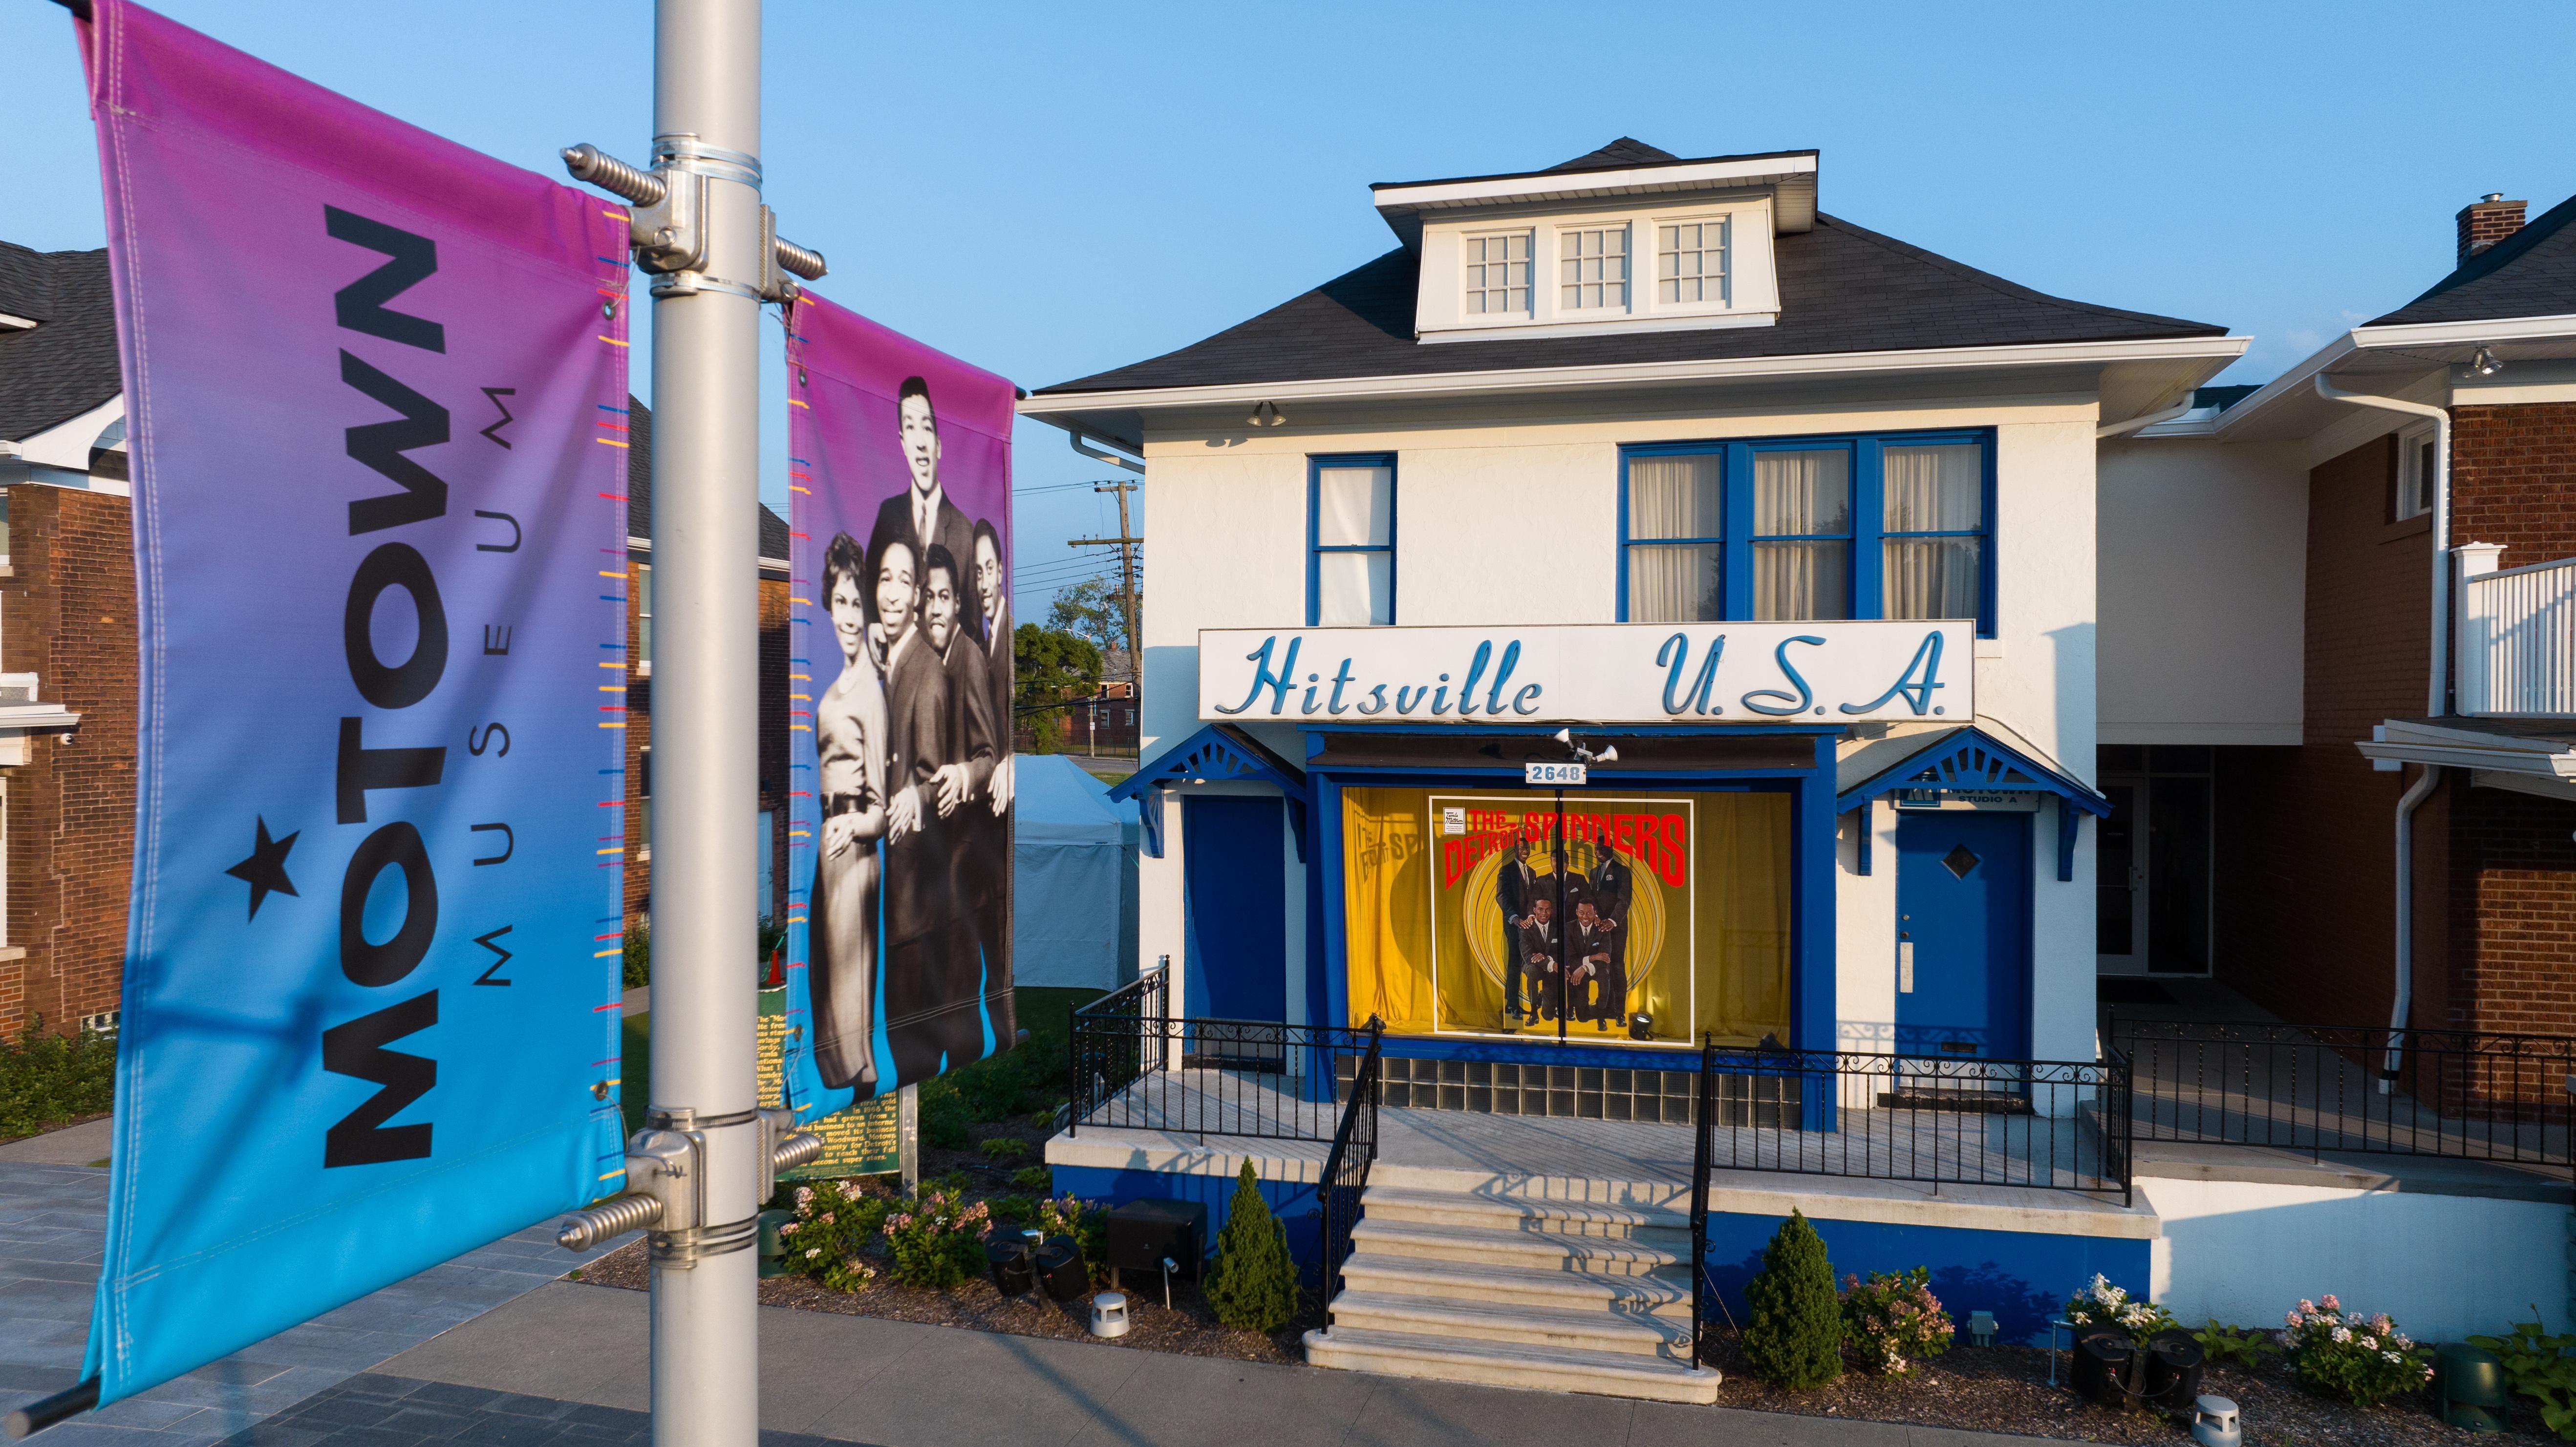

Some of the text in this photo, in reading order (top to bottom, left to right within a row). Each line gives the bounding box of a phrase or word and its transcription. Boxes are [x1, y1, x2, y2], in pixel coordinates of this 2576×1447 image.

[323, 203, 451, 1169] MOTOWN
[470, 386, 522, 987] MUSEUM
[1214, 635, 1542, 716] Hitsville
[1533, 766, 1579, 780] 2648
[1469, 809, 1518, 832] THE
[1443, 829, 1520, 891] DETROIT
[1524, 811, 1685, 888] SPINNERS
[880, 1098, 896, 1106] gold
[842, 1156, 863, 1164] super
[864, 1139, 897, 1148] Detroit's
